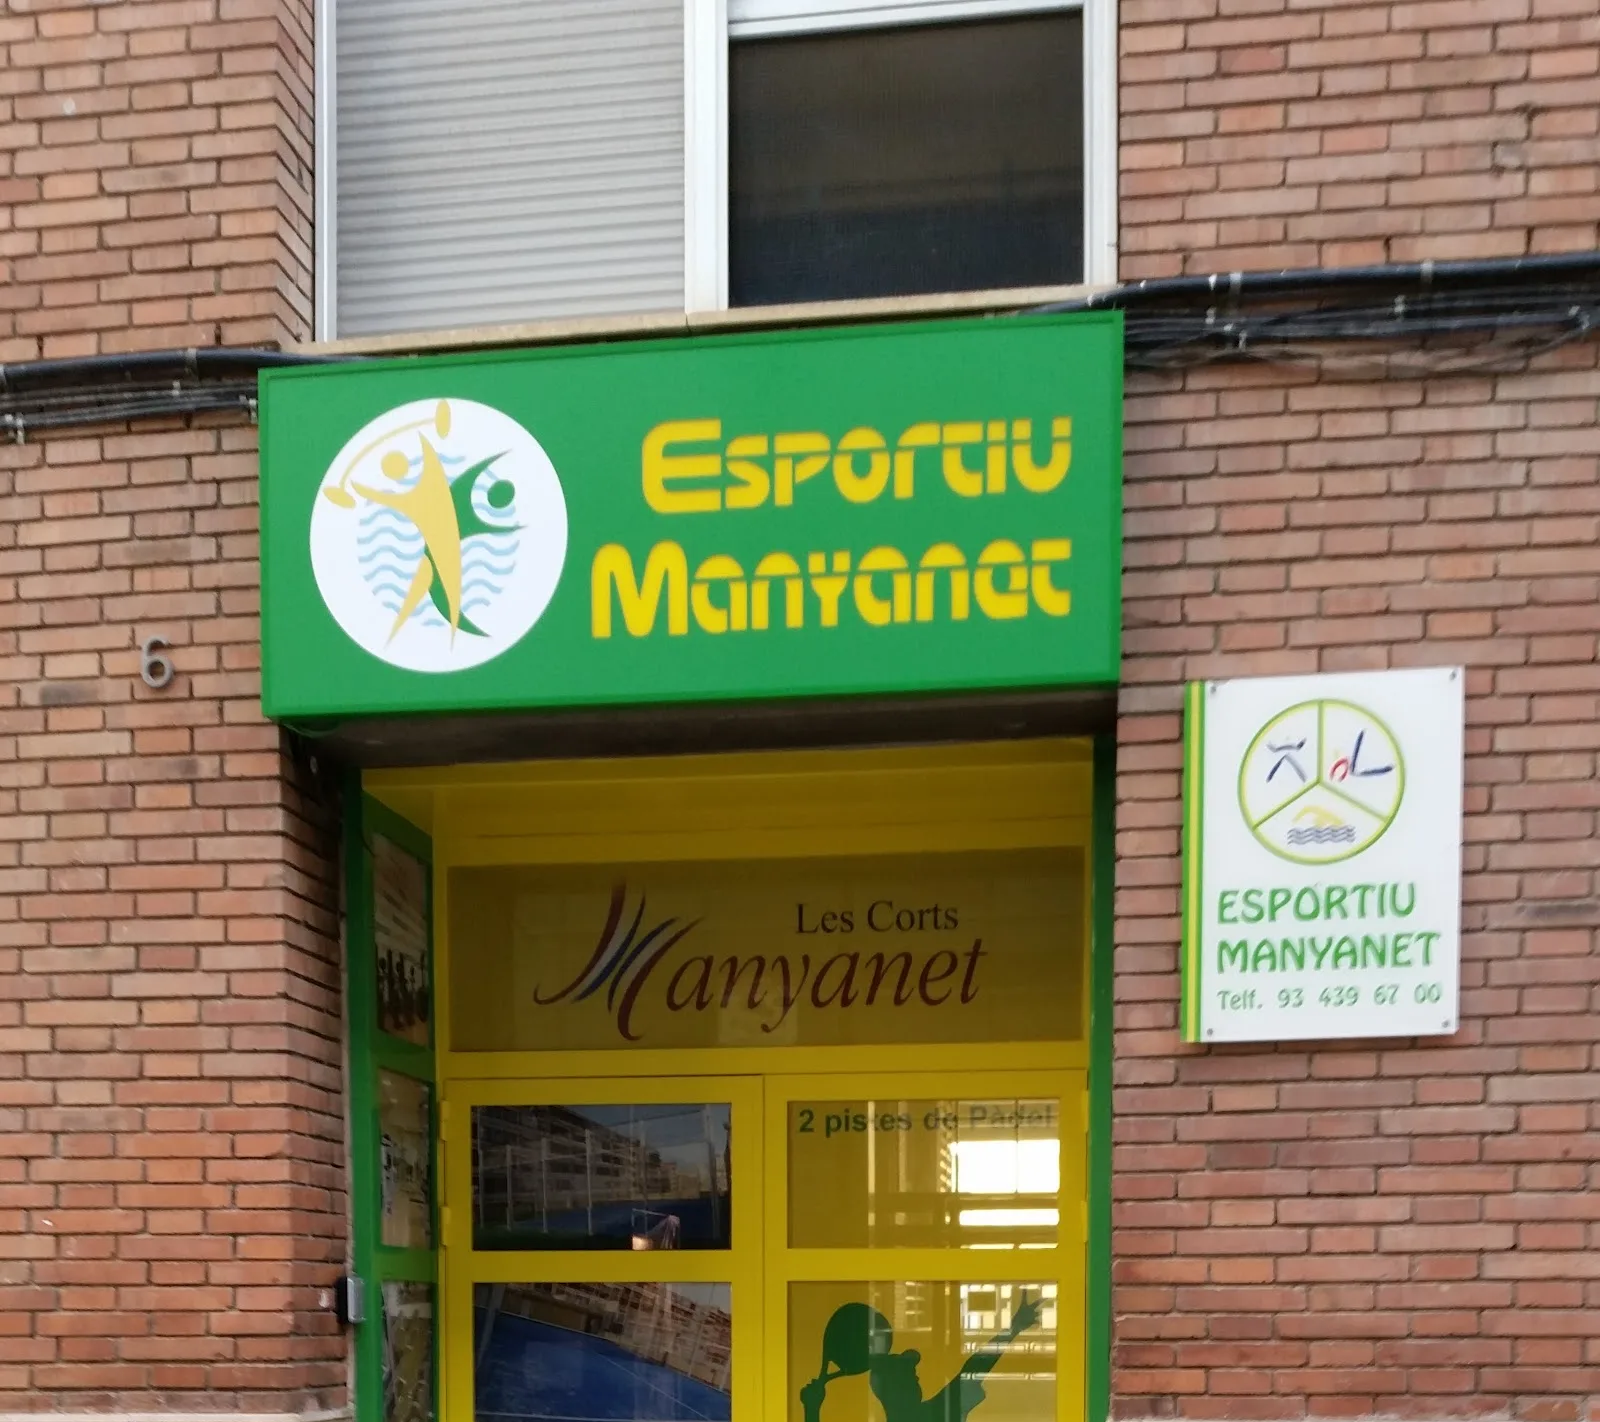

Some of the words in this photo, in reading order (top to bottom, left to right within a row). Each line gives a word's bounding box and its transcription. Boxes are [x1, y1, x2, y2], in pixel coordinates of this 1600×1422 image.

[142, 635, 172, 688] 6
[795, 903, 854, 935] Les
[867, 900, 960, 931] Corts
[1217, 882, 1416, 925] ESPORTIU
[533, 879, 988, 1042] Manyanet
[1216, 931, 1440, 975] MANYANET
[1217, 988, 1263, 1011] Telf.
[1277, 987, 1304, 1009] 93
[1318, 985, 1360, 1008] 439
[1373, 984, 1400, 1006] 67
[1413, 982, 1442, 1005] 00
[799, 1108, 815, 1133] 2
[923, 1107, 959, 1131] de
